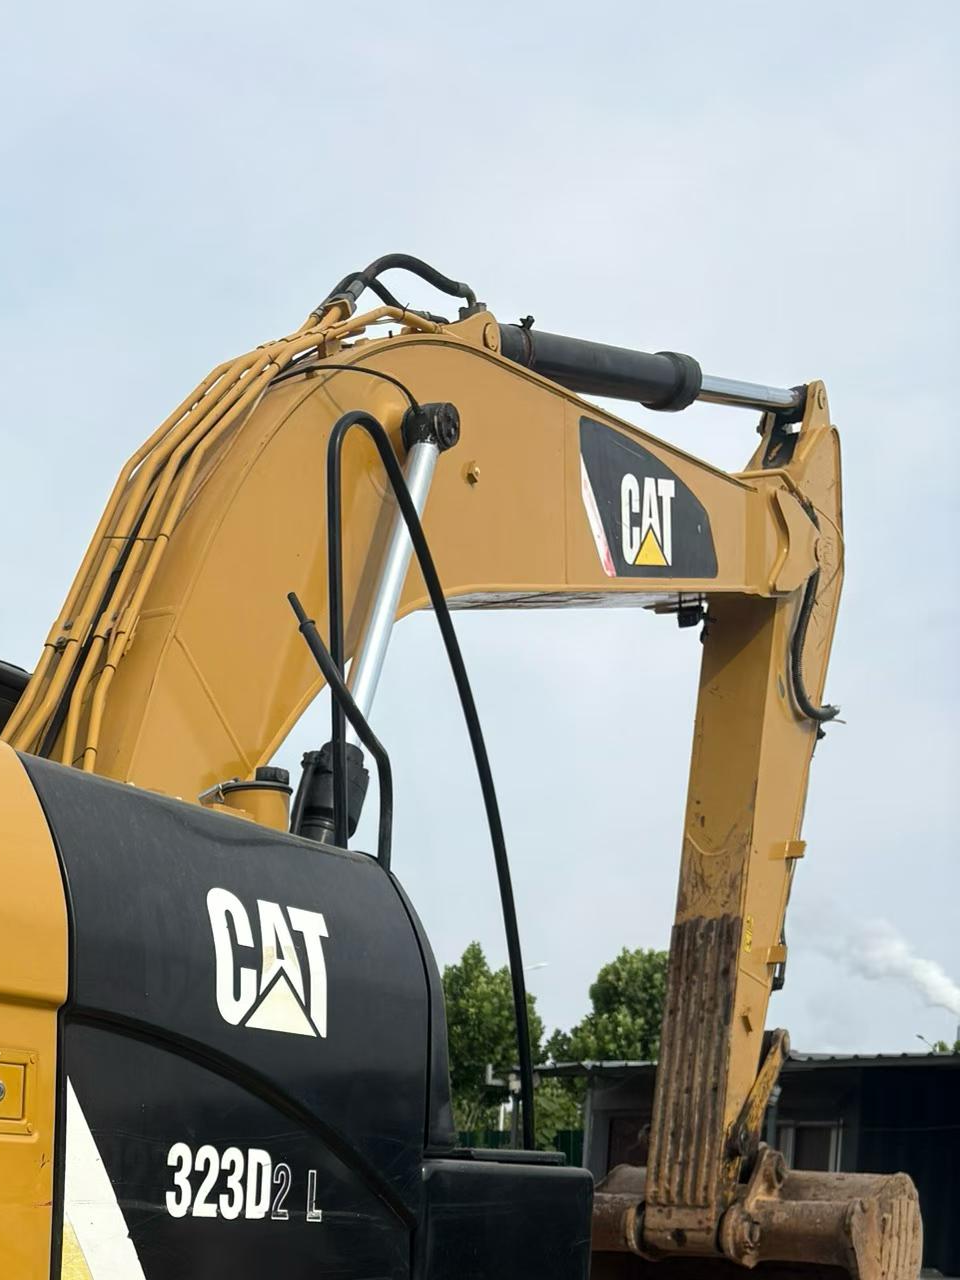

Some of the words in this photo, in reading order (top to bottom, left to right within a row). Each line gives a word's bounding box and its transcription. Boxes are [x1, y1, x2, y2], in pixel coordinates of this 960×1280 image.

[621, 473, 675, 566] CAT
[206, 887, 329, 1038] CAT
[165, 1142, 291, 1220] 323D2
[306, 1170, 322, 1222] L
